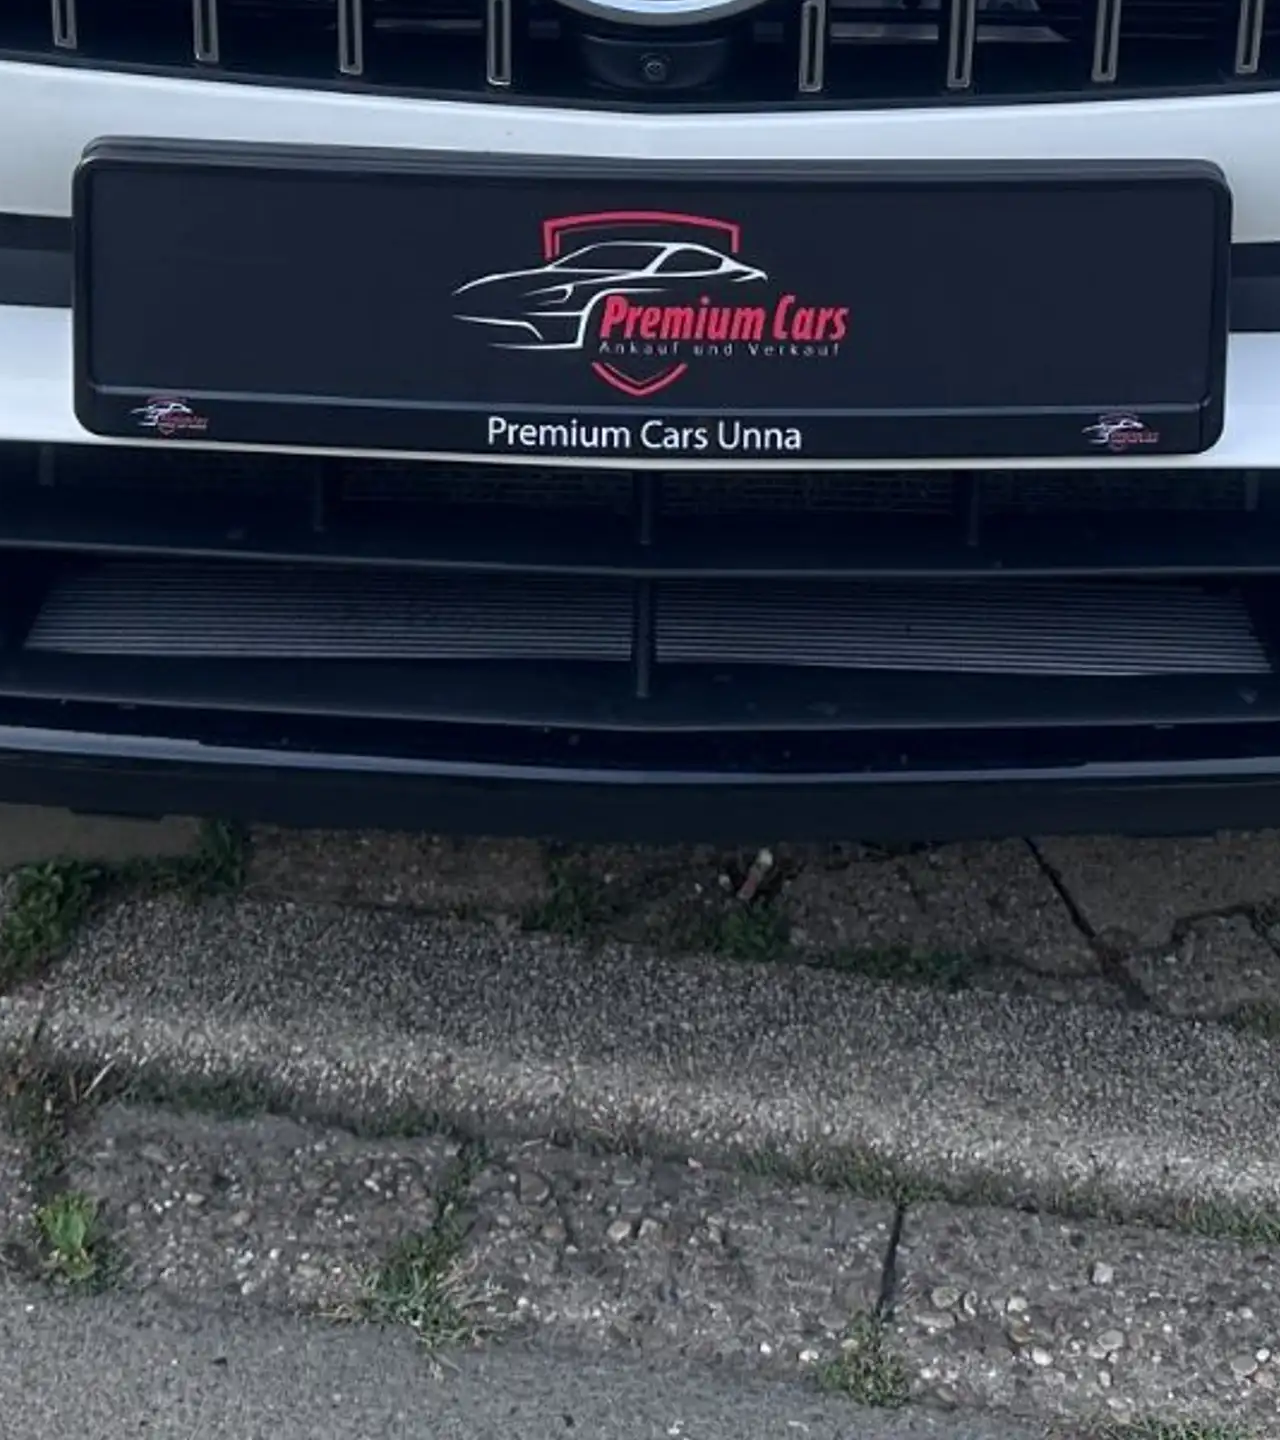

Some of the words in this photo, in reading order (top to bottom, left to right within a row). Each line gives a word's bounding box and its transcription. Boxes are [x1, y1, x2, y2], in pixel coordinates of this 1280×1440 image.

[599, 294, 768, 342] Premium
[771, 292, 849, 341] Cars
[598, 341, 680, 356] Ankauf
[693, 341, 734, 357] und
[747, 342, 841, 357] Verkauf
[487, 415, 631, 448] Premium
[639, 419, 709, 450] Cars
[718, 420, 803, 451] Unna
